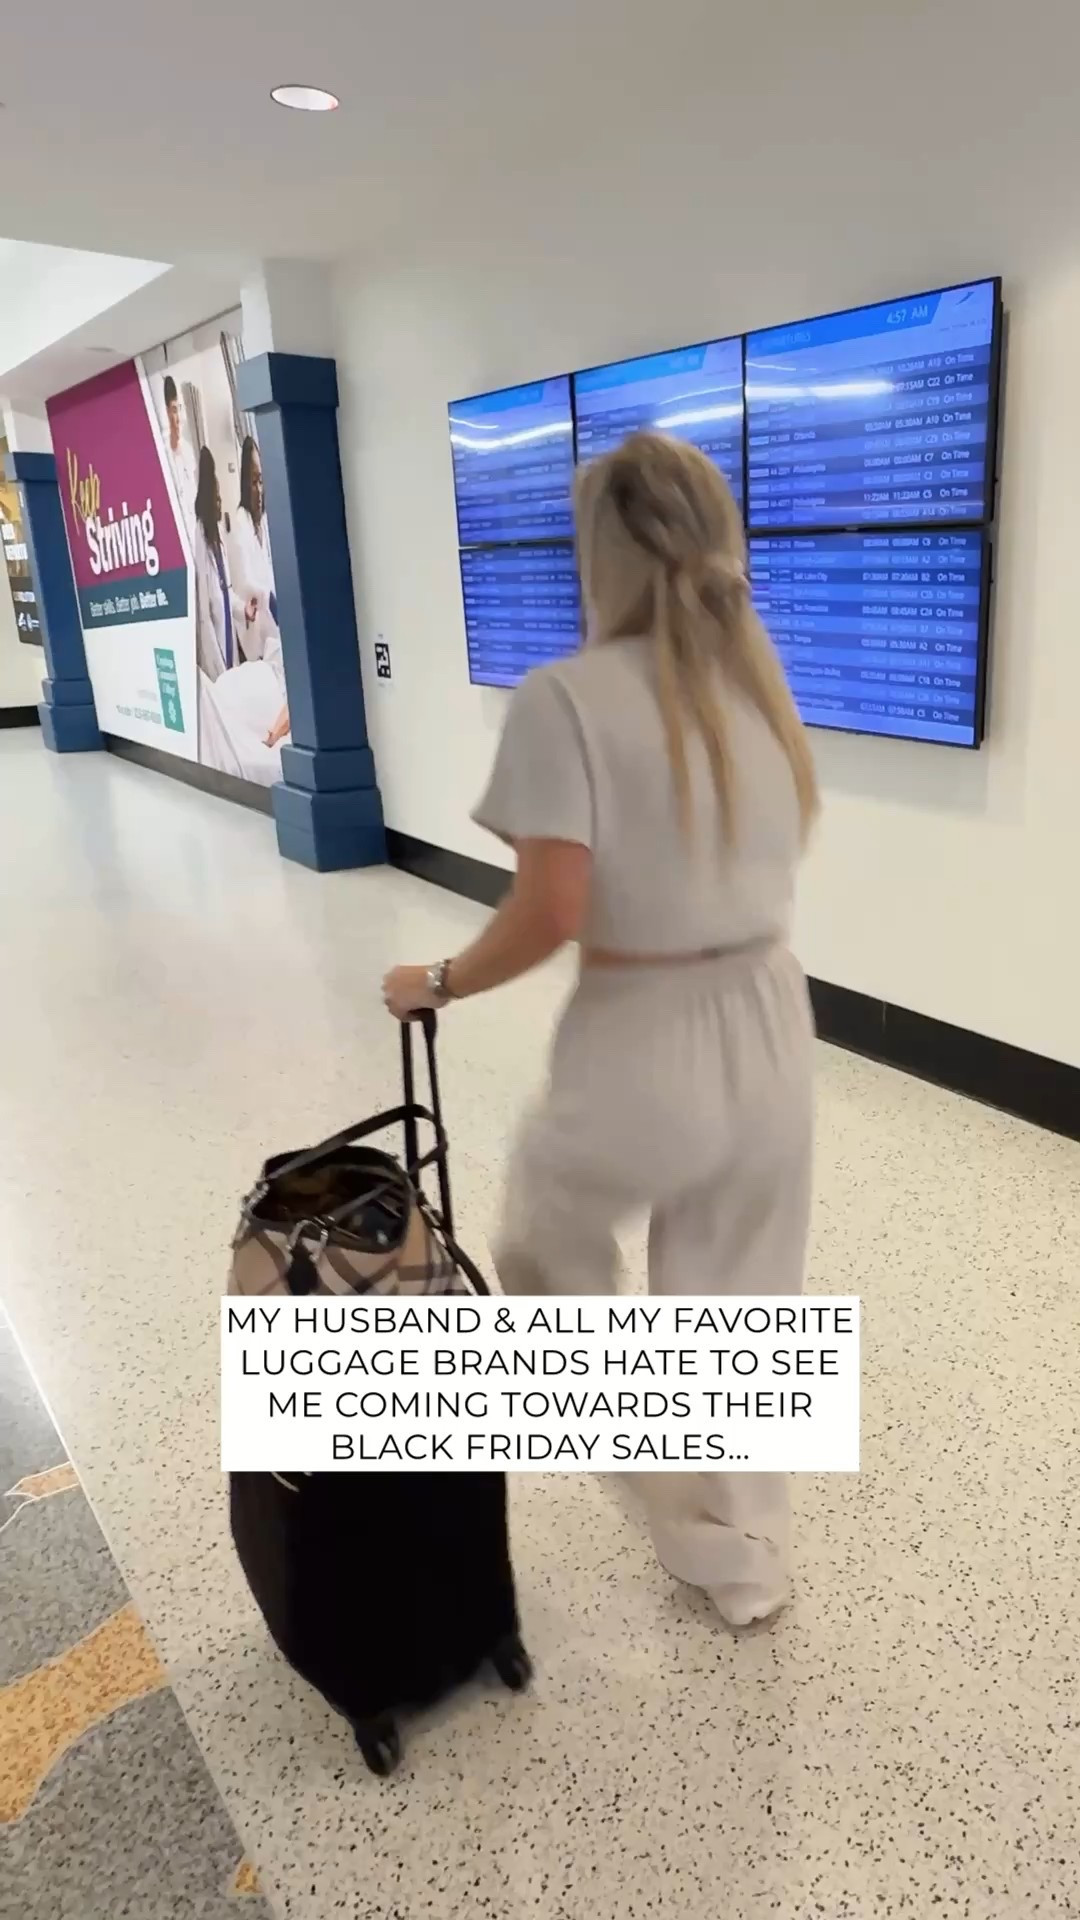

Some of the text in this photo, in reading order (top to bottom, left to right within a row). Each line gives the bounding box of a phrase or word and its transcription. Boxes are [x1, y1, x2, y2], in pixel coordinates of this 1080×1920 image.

[886, 305, 928, 324] 4:57 AM
[67, 447, 100, 537] Keep
[86, 498, 159, 576] Striving
